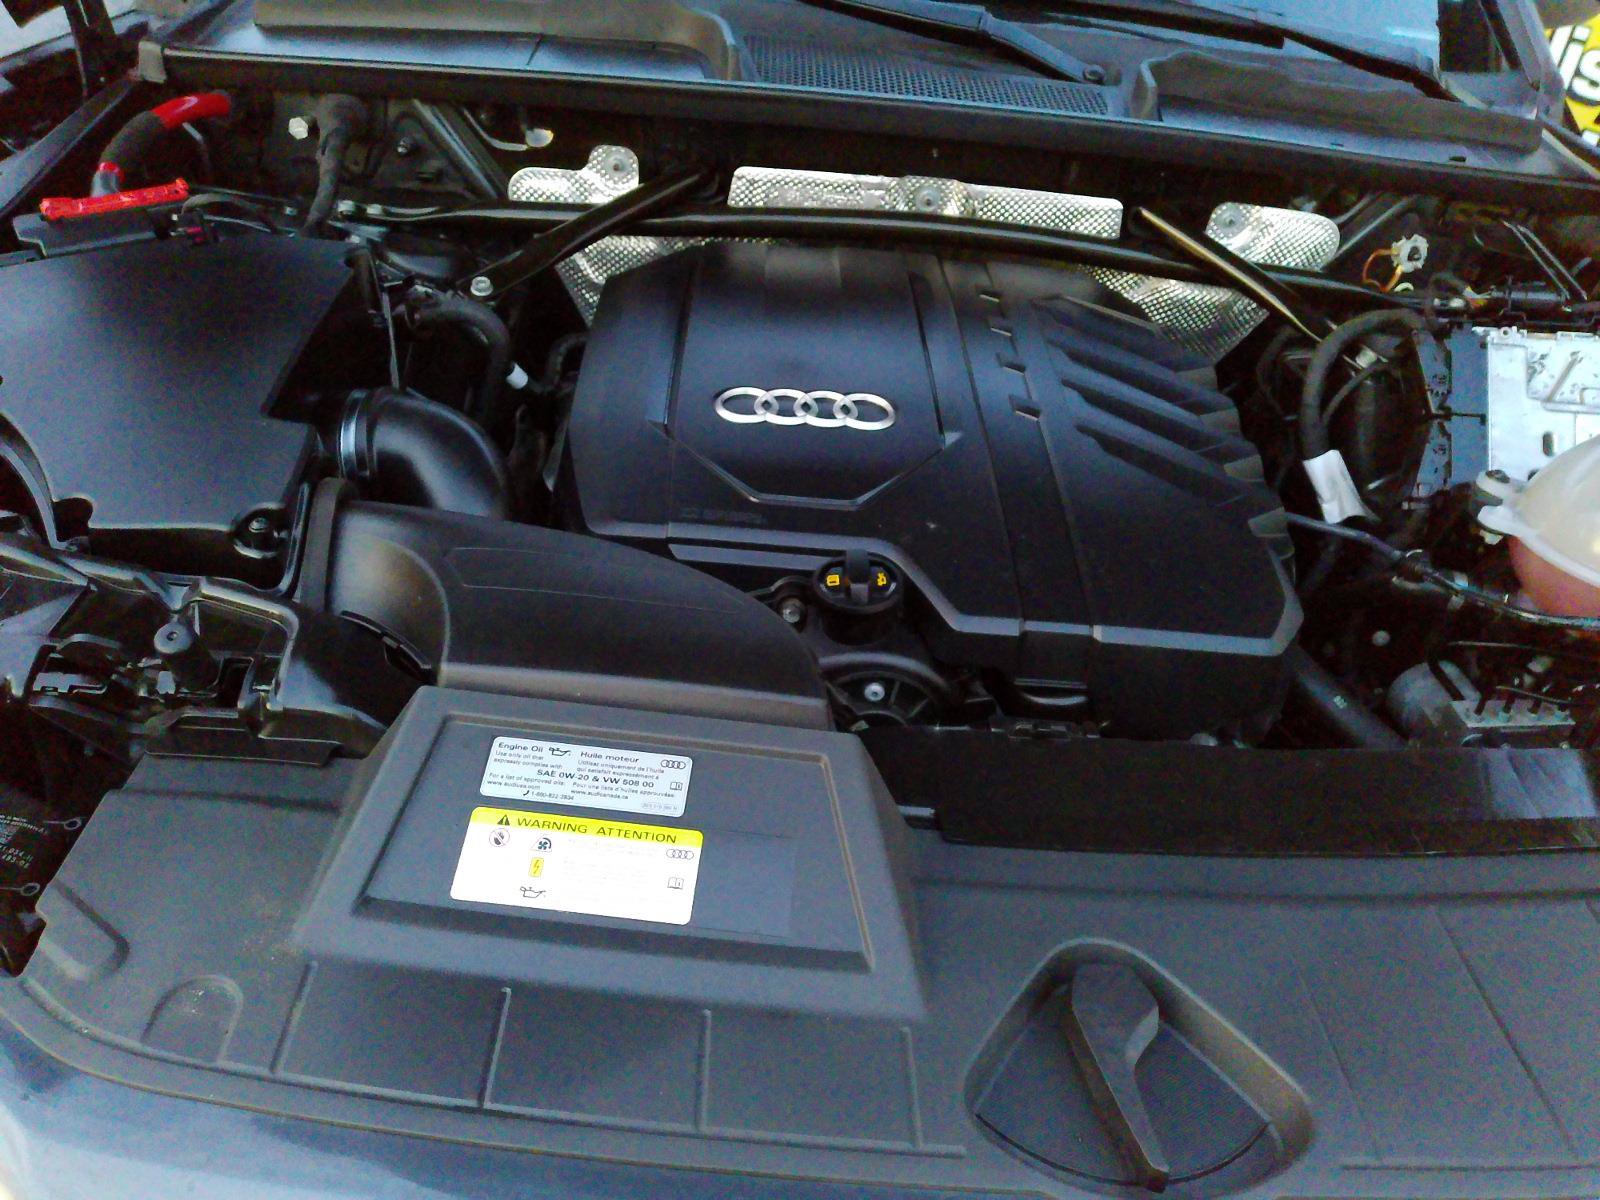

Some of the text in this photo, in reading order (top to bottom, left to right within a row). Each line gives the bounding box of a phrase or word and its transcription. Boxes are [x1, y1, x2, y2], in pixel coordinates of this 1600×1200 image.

[498, 742, 528, 751] Engine
[580, 751, 639, 763] Huile moteur
[537, 769, 556, 777] SAE
[558, 772, 590, 780] 0W-20
[622, 779, 640, 787] 508
[517, 817, 677, 844] WARNING ATTENTION
